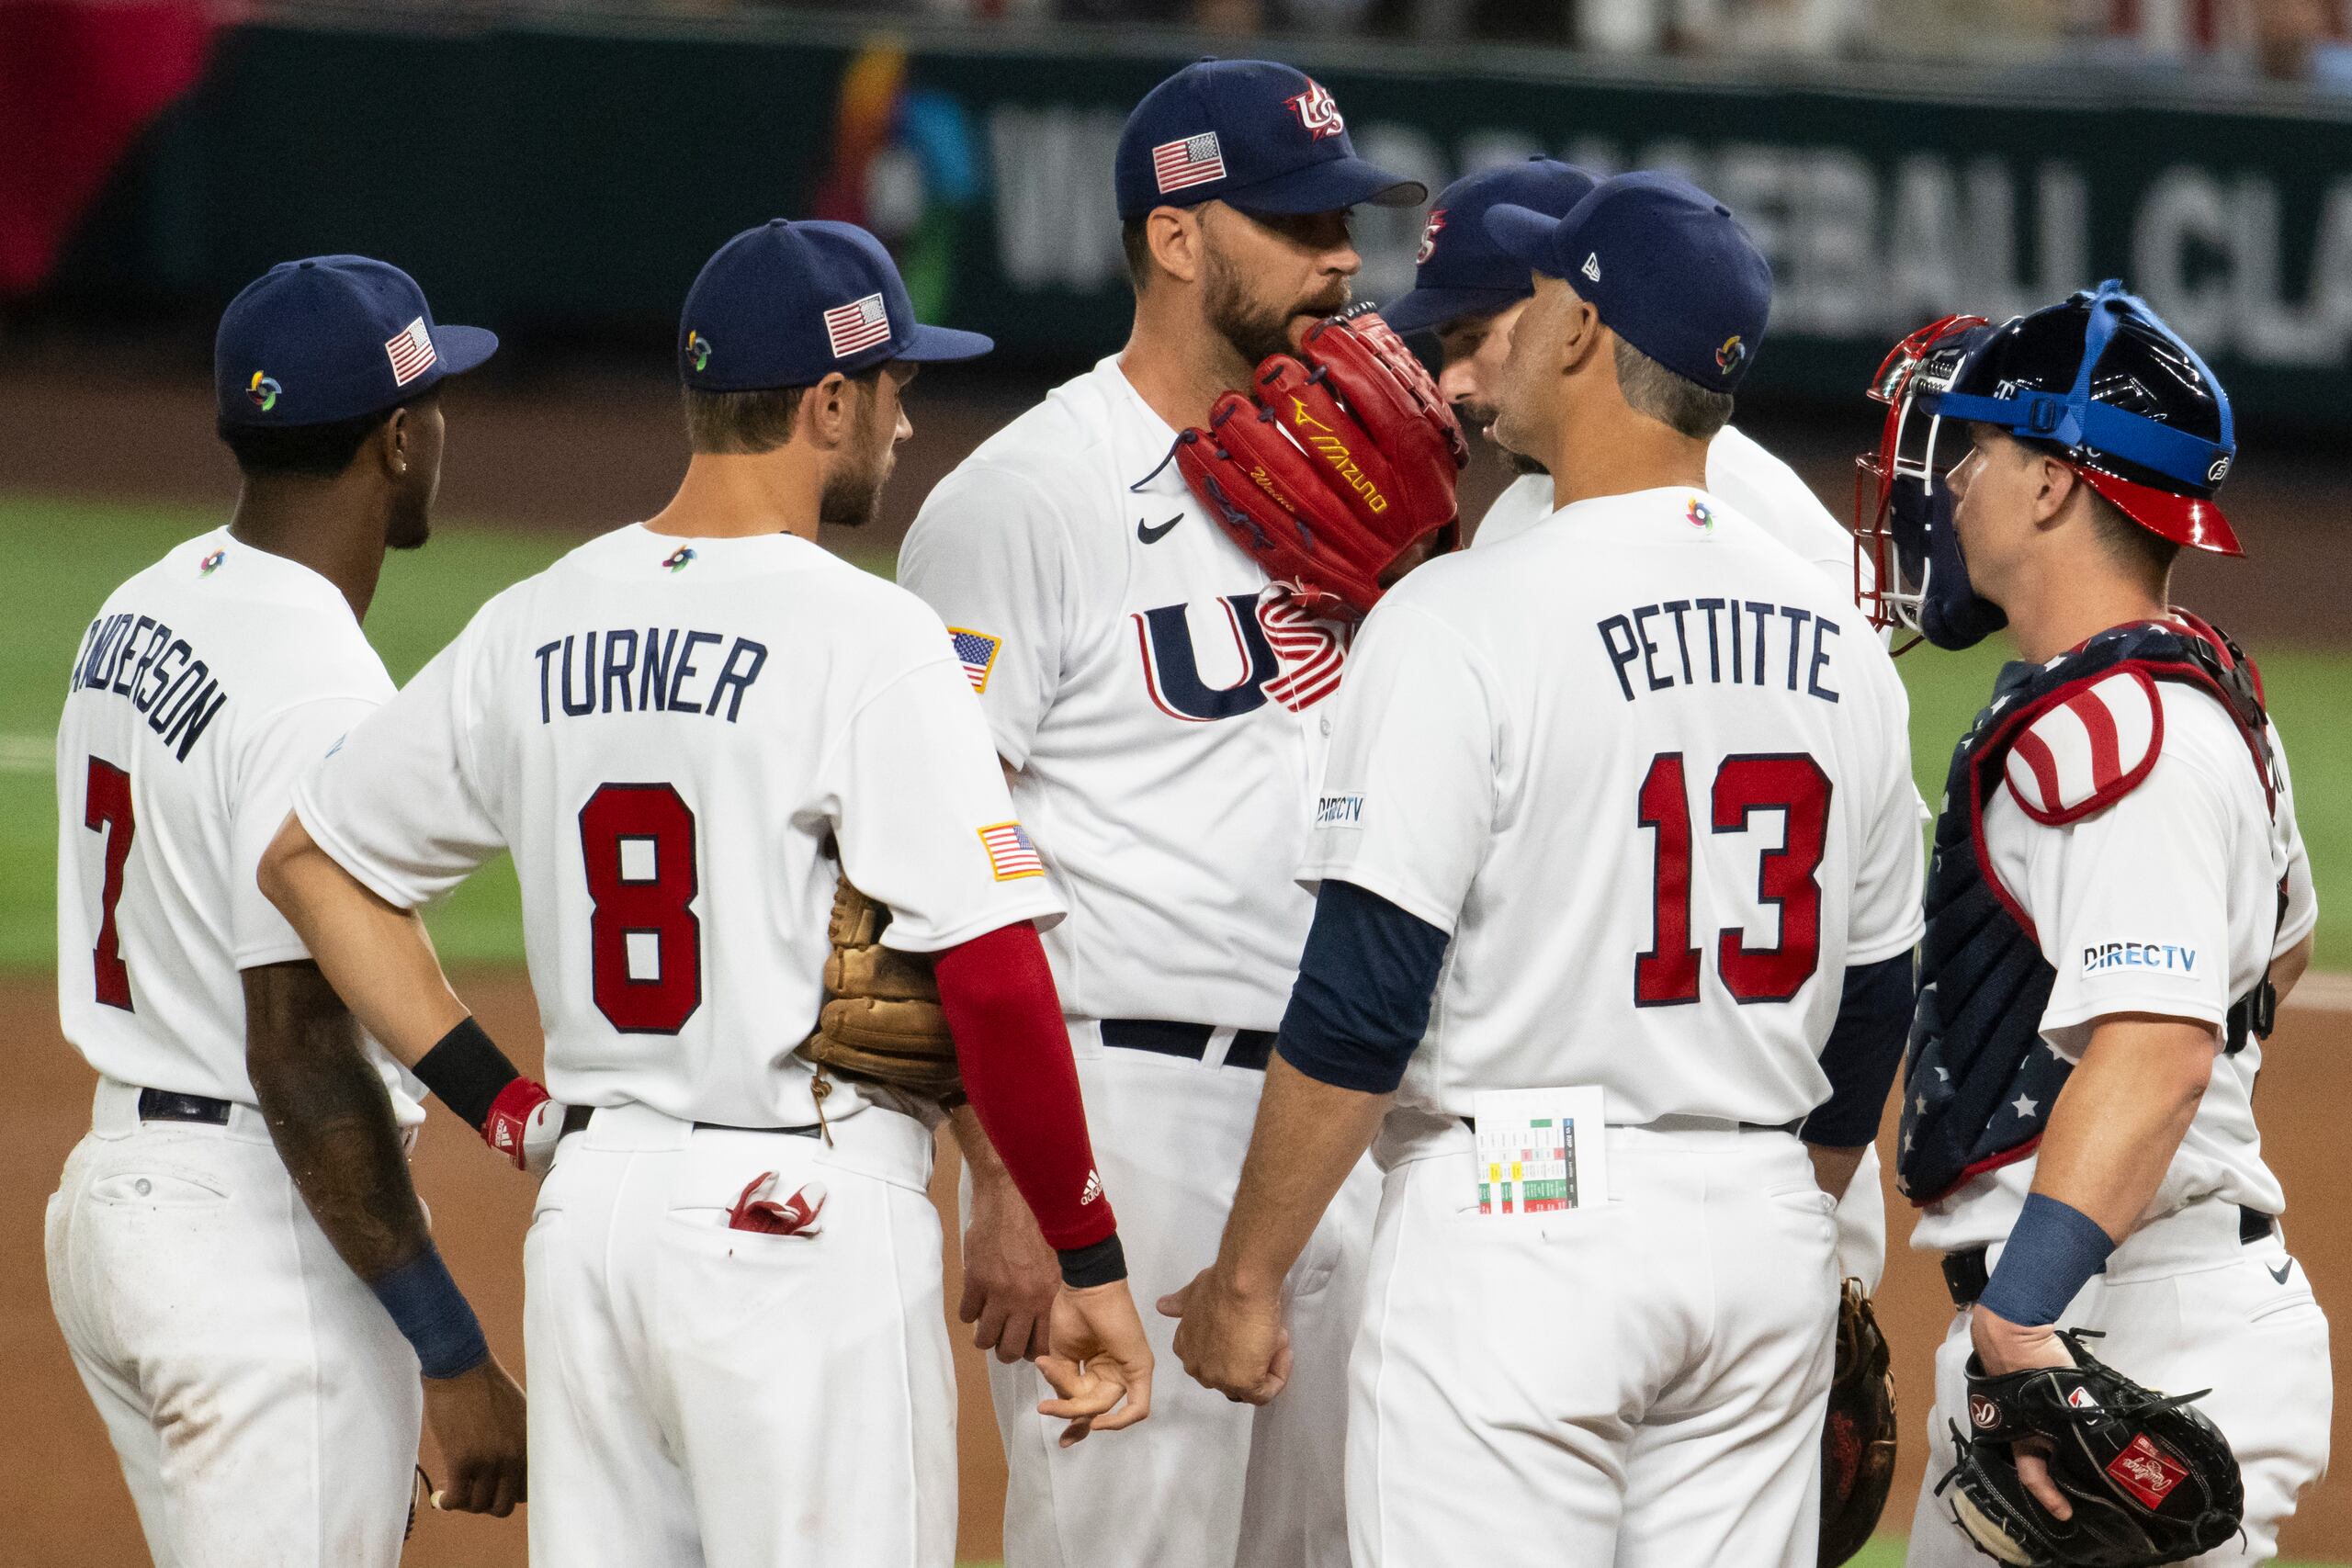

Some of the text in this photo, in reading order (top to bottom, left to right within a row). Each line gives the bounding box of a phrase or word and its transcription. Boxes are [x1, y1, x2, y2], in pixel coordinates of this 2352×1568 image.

[72, 613, 228, 763] ANDERSON
[535, 627, 769, 725] TURNER
[1597, 597, 1840, 704] PETTITTE
[85, 754, 136, 1014] 7
[578, 782, 702, 1035] 8
[1634, 751, 1834, 1009] 13
[2084, 942, 2196, 972] DIRECTV
[2122, 1457, 2172, 1491] Rawlings
